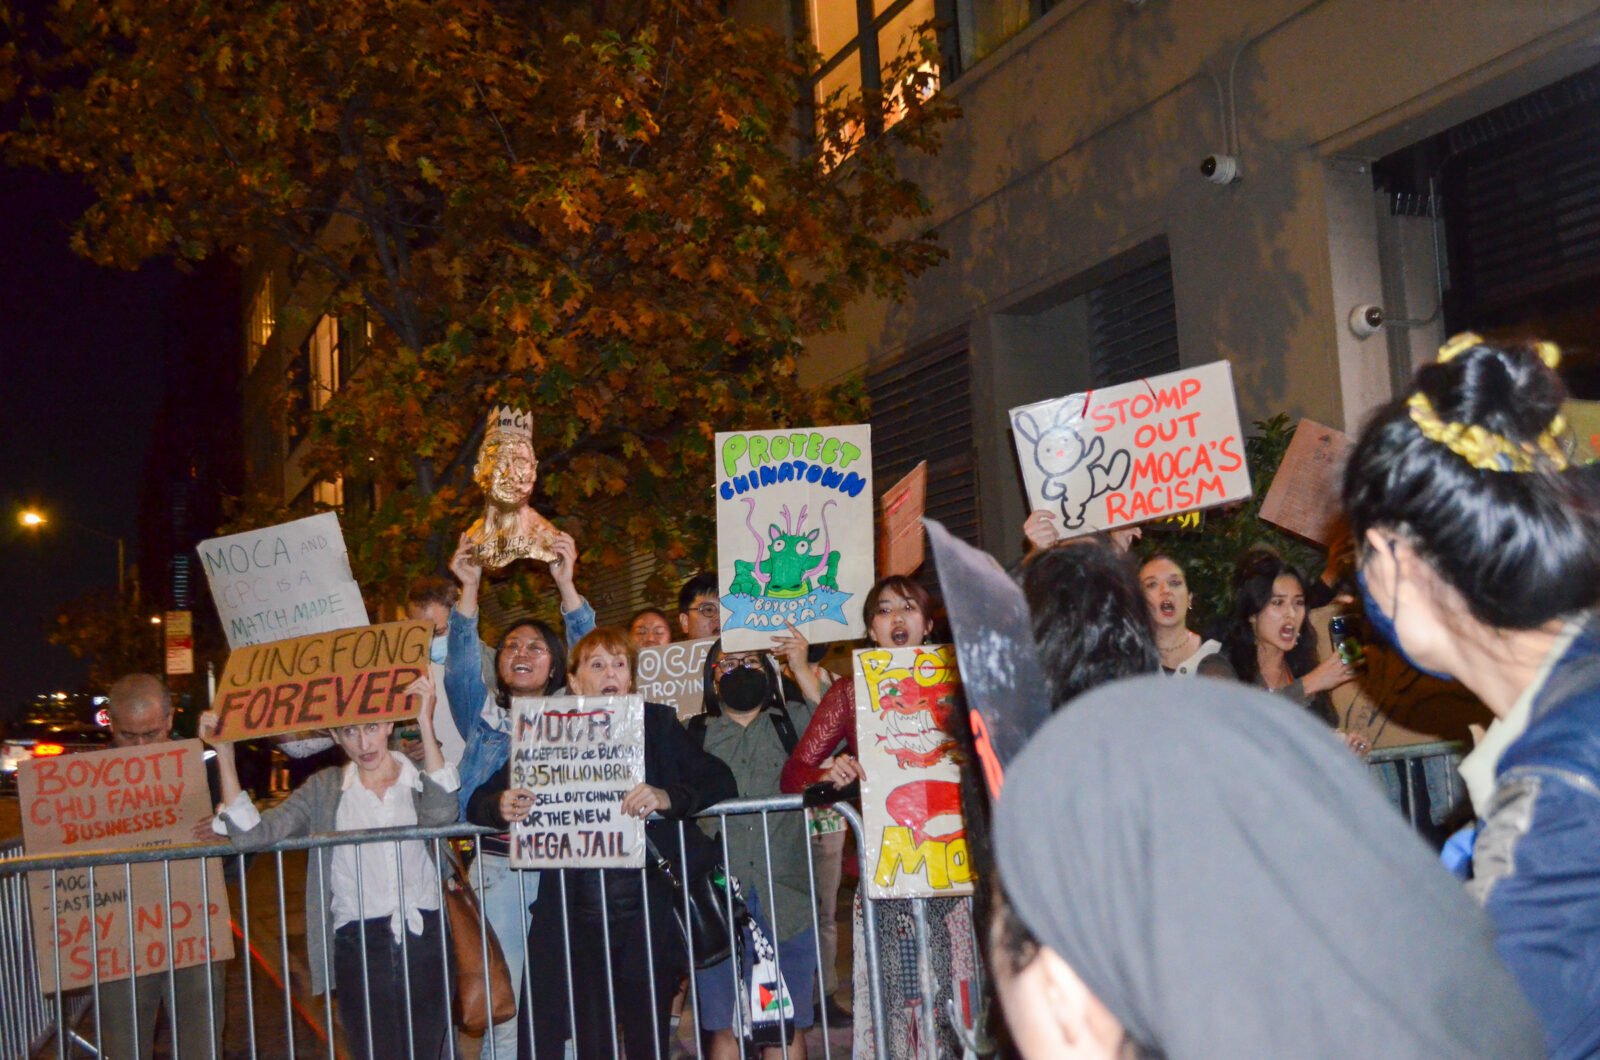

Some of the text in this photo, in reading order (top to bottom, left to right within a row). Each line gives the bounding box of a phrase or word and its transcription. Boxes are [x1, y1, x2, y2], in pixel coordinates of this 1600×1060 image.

[1091, 378, 1201, 432] STOMP
[1134, 412, 1201, 449] OUT
[722, 432, 861, 477] PROTECT
[1129, 436, 1242, 490] MOCA'S
[720, 460, 866, 500] CHINATOWN
[1105, 475, 1226, 524] RACISM
[205, 535, 328, 576] MOCA AND
[222, 570, 312, 609] CPC IS A
[754, 594, 817, 613] BOYCOTT
[231, 608, 288, 640] MATCH
[293, 593, 345, 623] MADE
[231, 639, 324, 687] JING
[330, 626, 427, 672] FONG
[637, 641, 715, 680] OCA
[214, 667, 422, 738] FOREVER
[638, 679, 704, 699] TROYIN
[32, 748, 189, 795] BOYCOTT
[515, 746, 578, 762] ACCEPTED
[582, 744, 597, 760] de
[514, 763, 634, 788] $35 MILLION BRIB
[31, 782, 185, 826] CHU FAMILY
[522, 808, 611, 828] OR THE NEW
[535, 790, 628, 806] SELL OUT CHINATO
[61, 808, 184, 845] BUSINESSES:
[516, 830, 630, 861] MEGA JAIL
[873, 826, 971, 890] MO
[48, 911, 114, 948] SAY
[137, 901, 193, 933] NO
